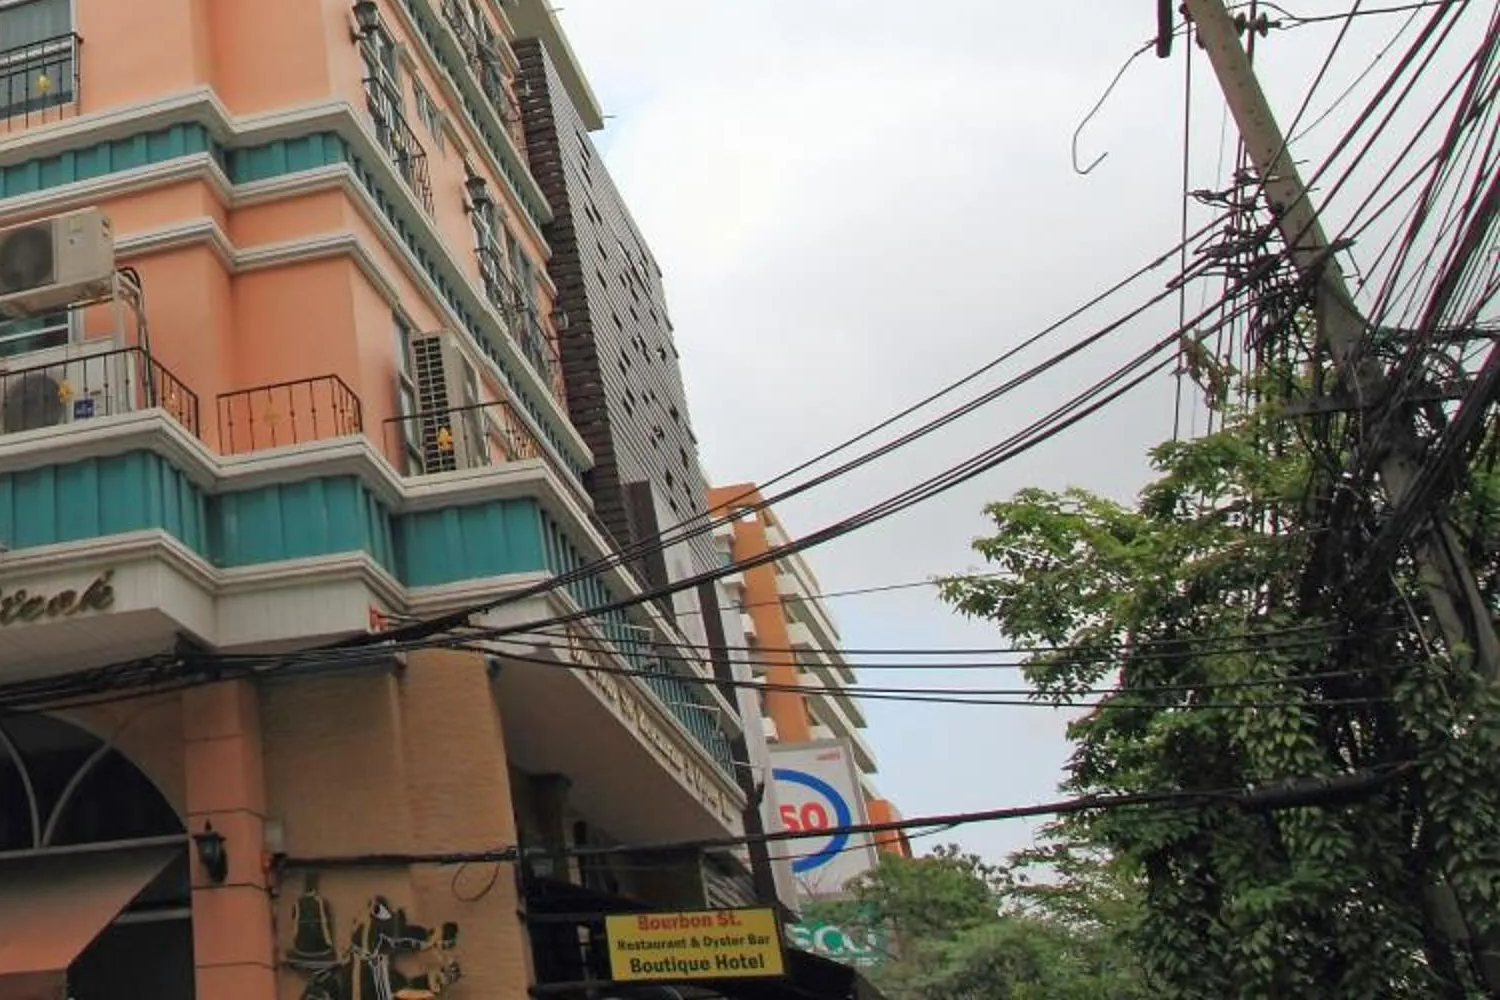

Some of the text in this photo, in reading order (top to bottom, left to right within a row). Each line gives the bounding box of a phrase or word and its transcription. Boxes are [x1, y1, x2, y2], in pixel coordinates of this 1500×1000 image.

[637, 911, 743, 931] Bourbon St.
[617, 937, 687, 951] Restaurant
[689, 937, 700, 949] &
[703, 934, 745, 949] Oyster
[747, 933, 771, 947] Bar
[629, 952, 766, 977] Boutique Hotel
